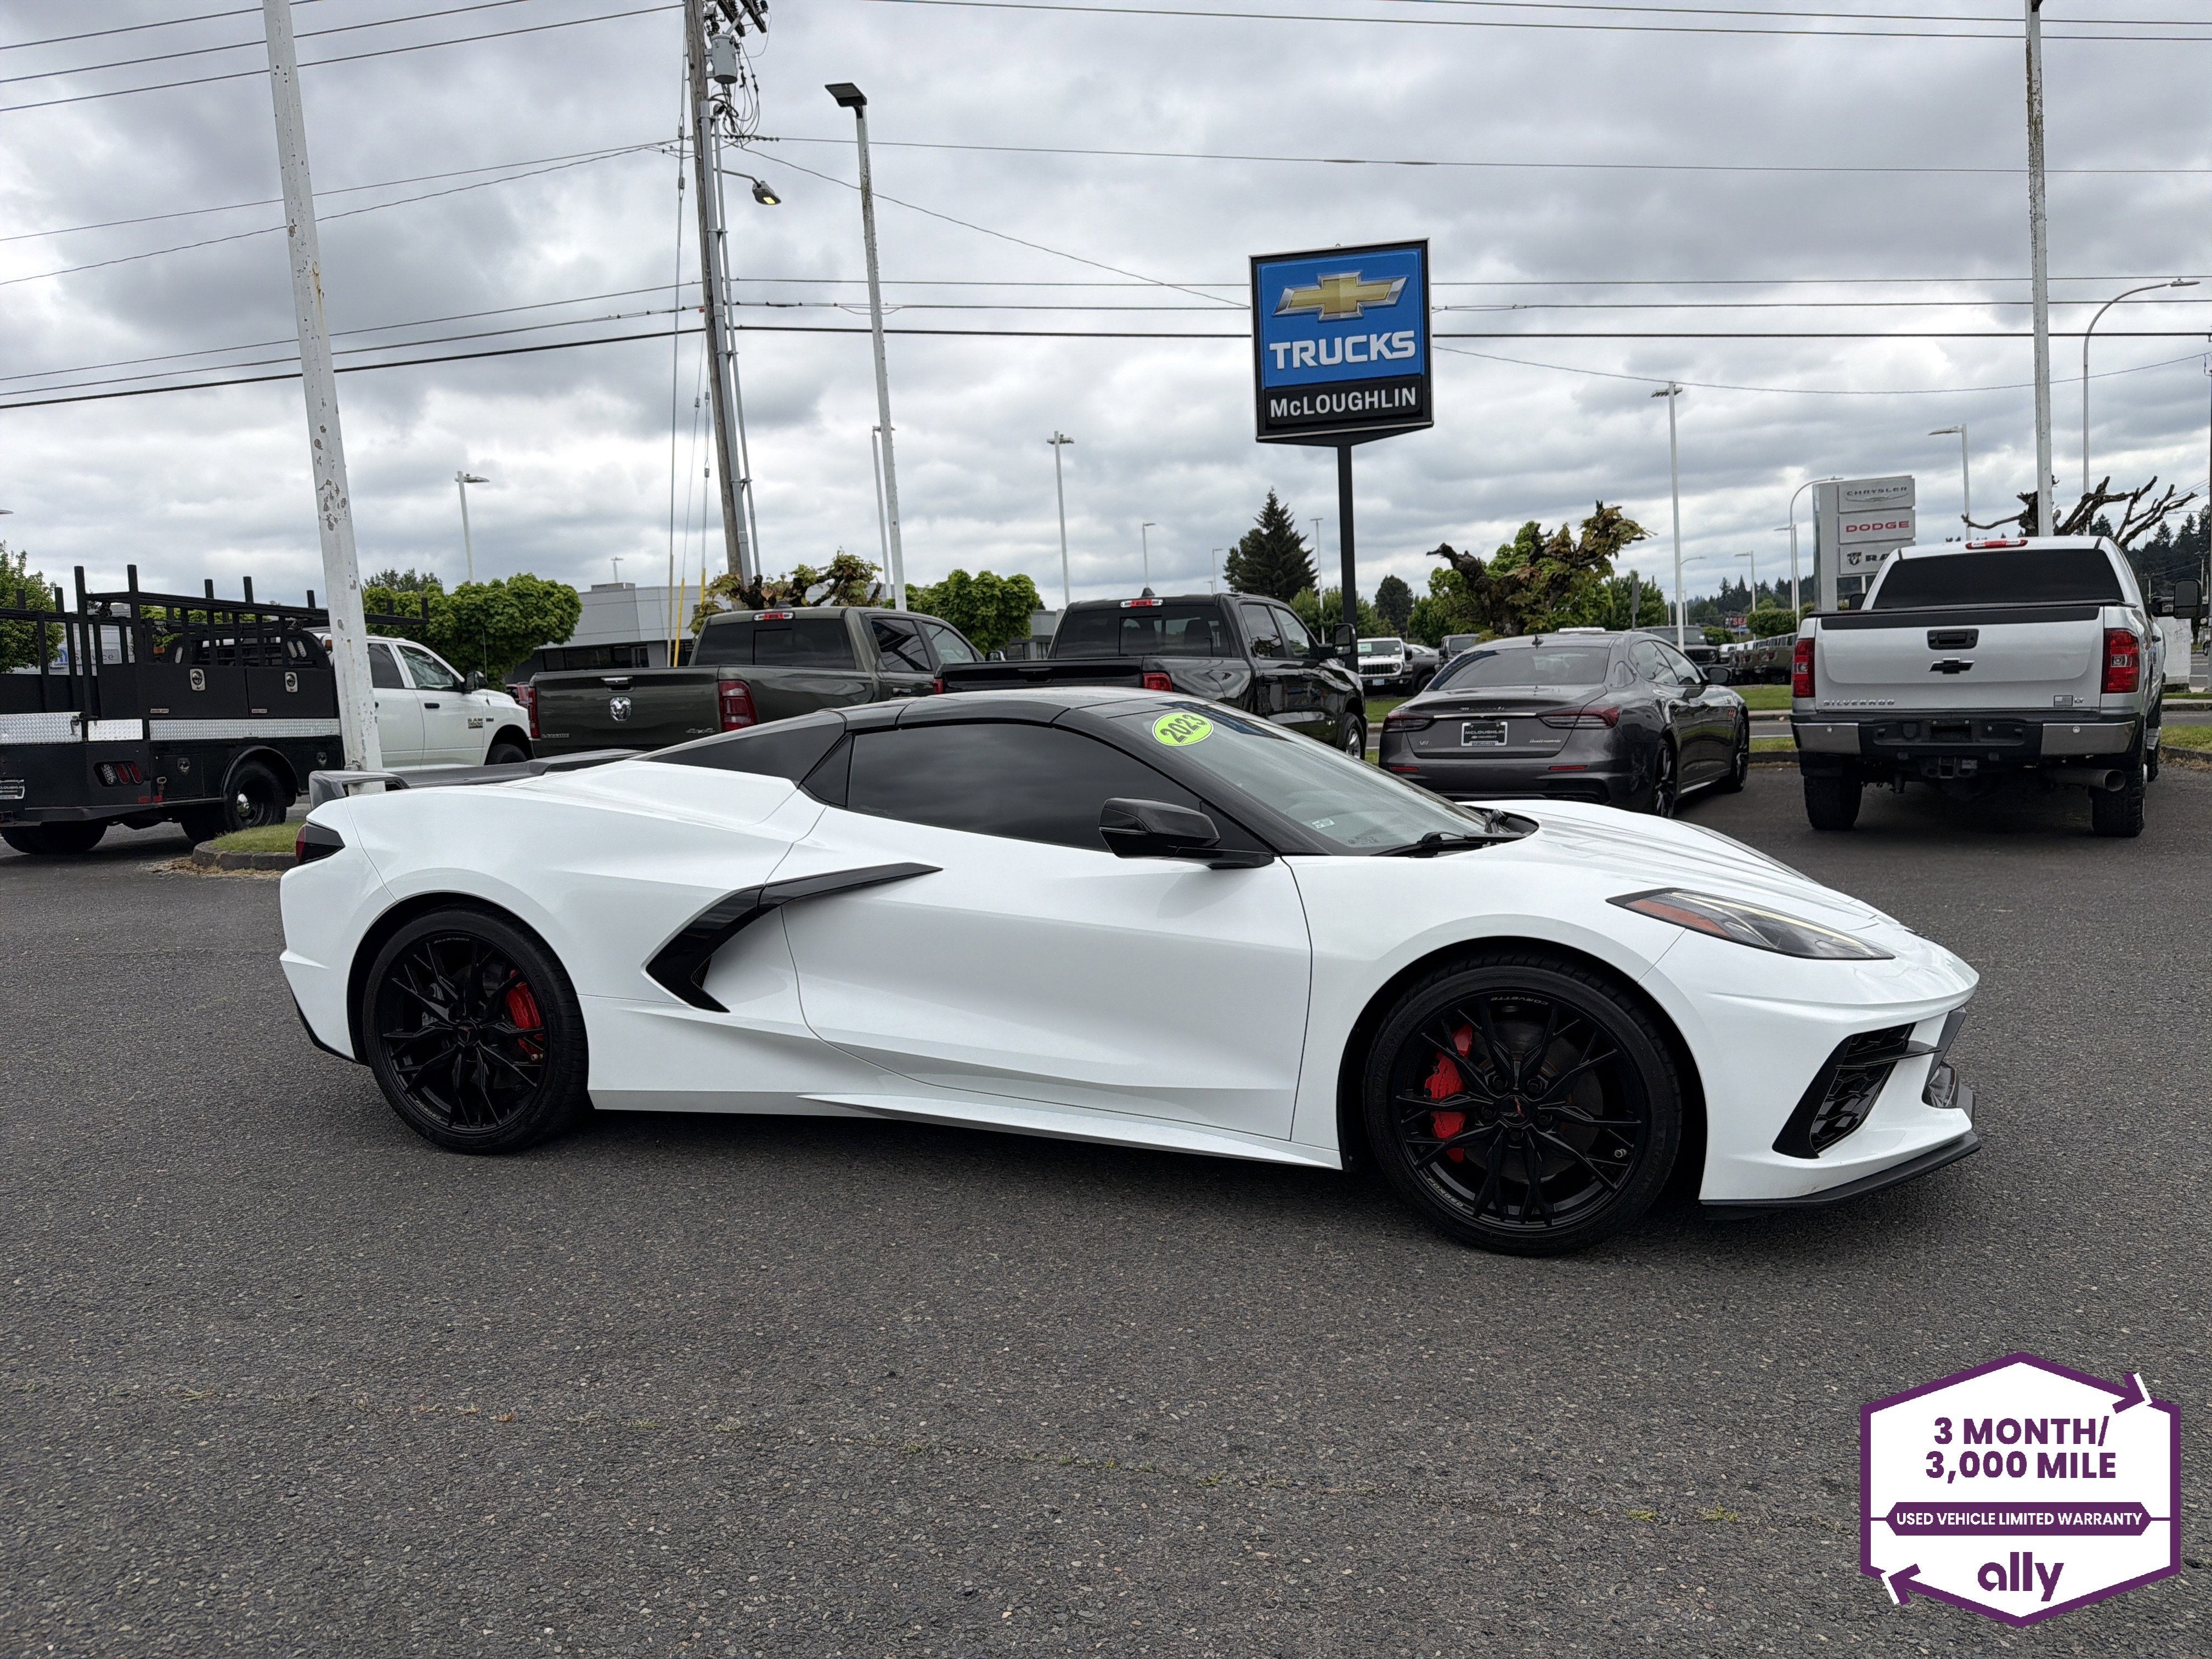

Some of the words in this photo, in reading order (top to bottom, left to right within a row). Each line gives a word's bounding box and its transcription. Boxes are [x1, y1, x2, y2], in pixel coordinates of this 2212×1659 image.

[1269, 330, 1415, 369] TRUCKS
[1270, 386, 1416, 418] McLOUGHLIN
[1847, 487, 1907, 496] CHRYSLER
[1846, 521, 1909, 533] DODGE
[1865, 553, 1891, 562] RA
[1160, 714, 1207, 743] 2023
